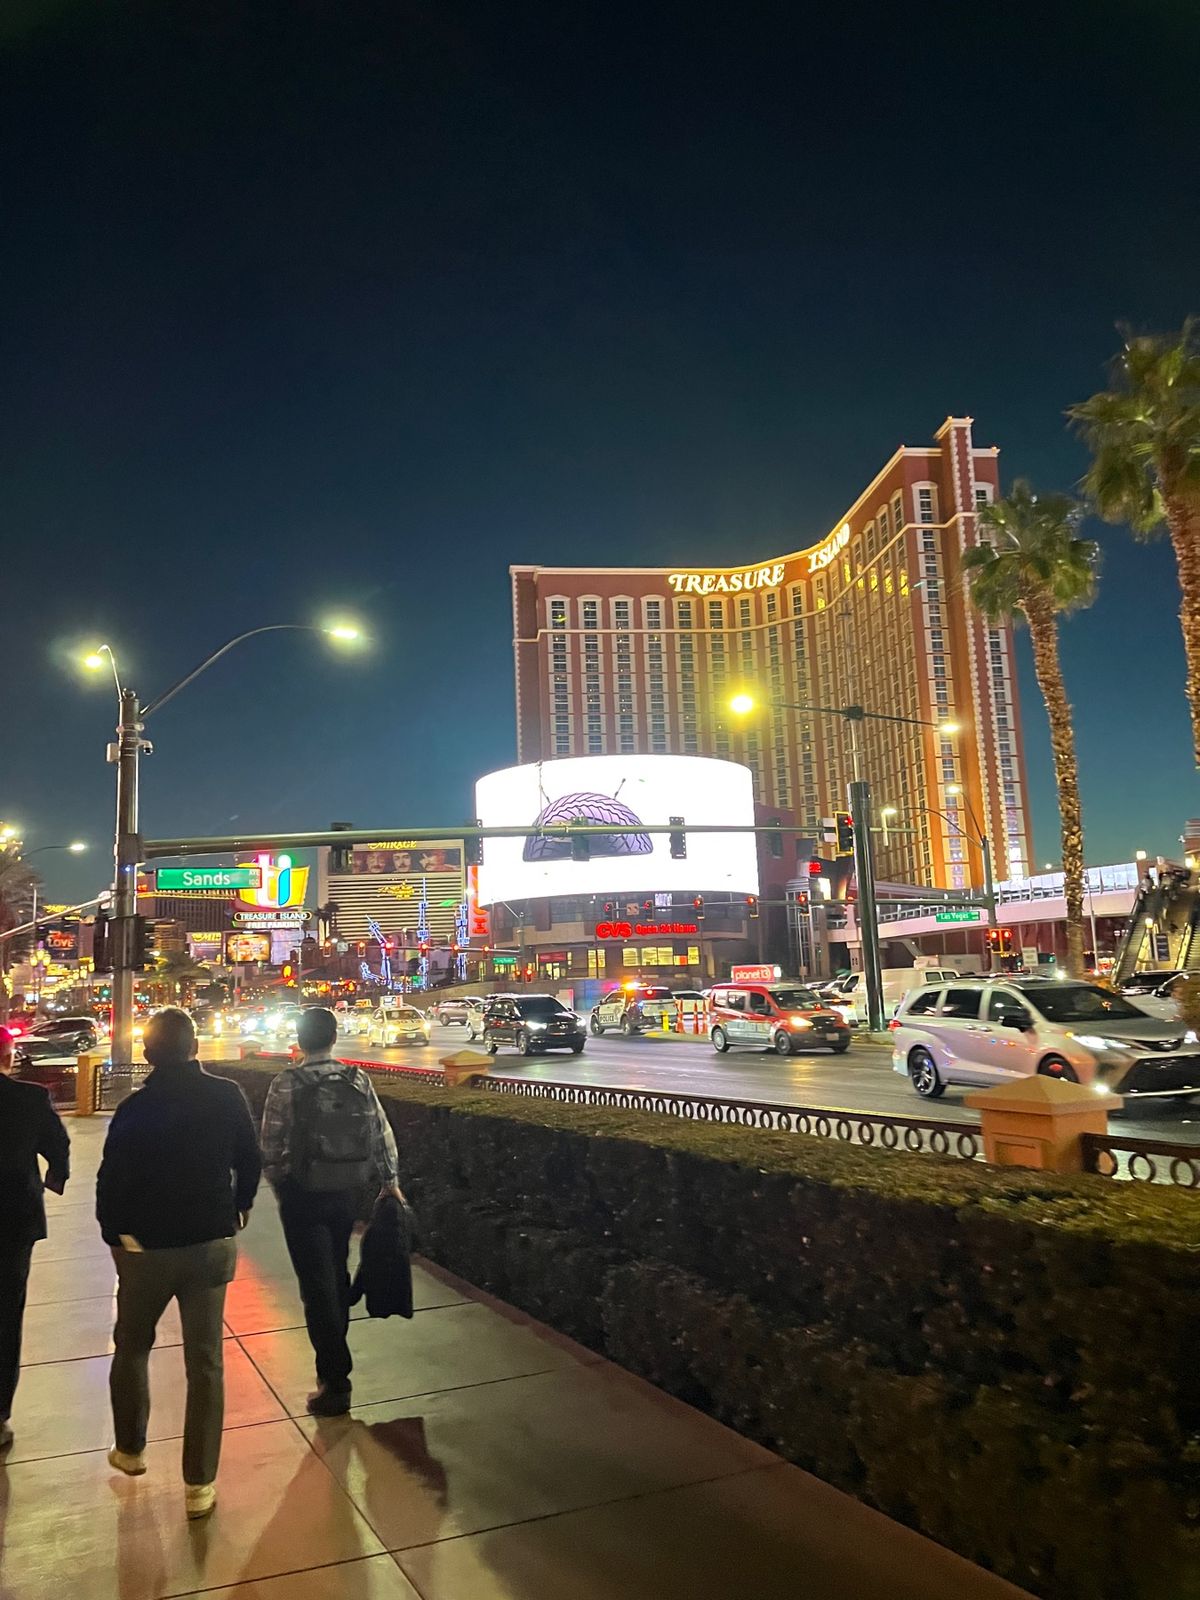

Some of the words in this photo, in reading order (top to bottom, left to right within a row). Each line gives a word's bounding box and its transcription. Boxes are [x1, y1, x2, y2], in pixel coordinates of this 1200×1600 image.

[668, 573, 785, 595] TREASURE
[807, 522, 851, 574] ISLAND
[182, 871, 231, 886] Sands
[240, 913, 267, 921] TREASURE
[280, 912, 308, 920] ISLAND
[951, 912, 969, 921] Vegas
[596, 922, 633, 938] CVS
[635, 923, 658, 935] Open
[660, 923, 671, 934] 24
[673, 923, 698, 934] Hours
[48, 938, 75, 948] LOVE
[735, 970, 760, 982] planet
